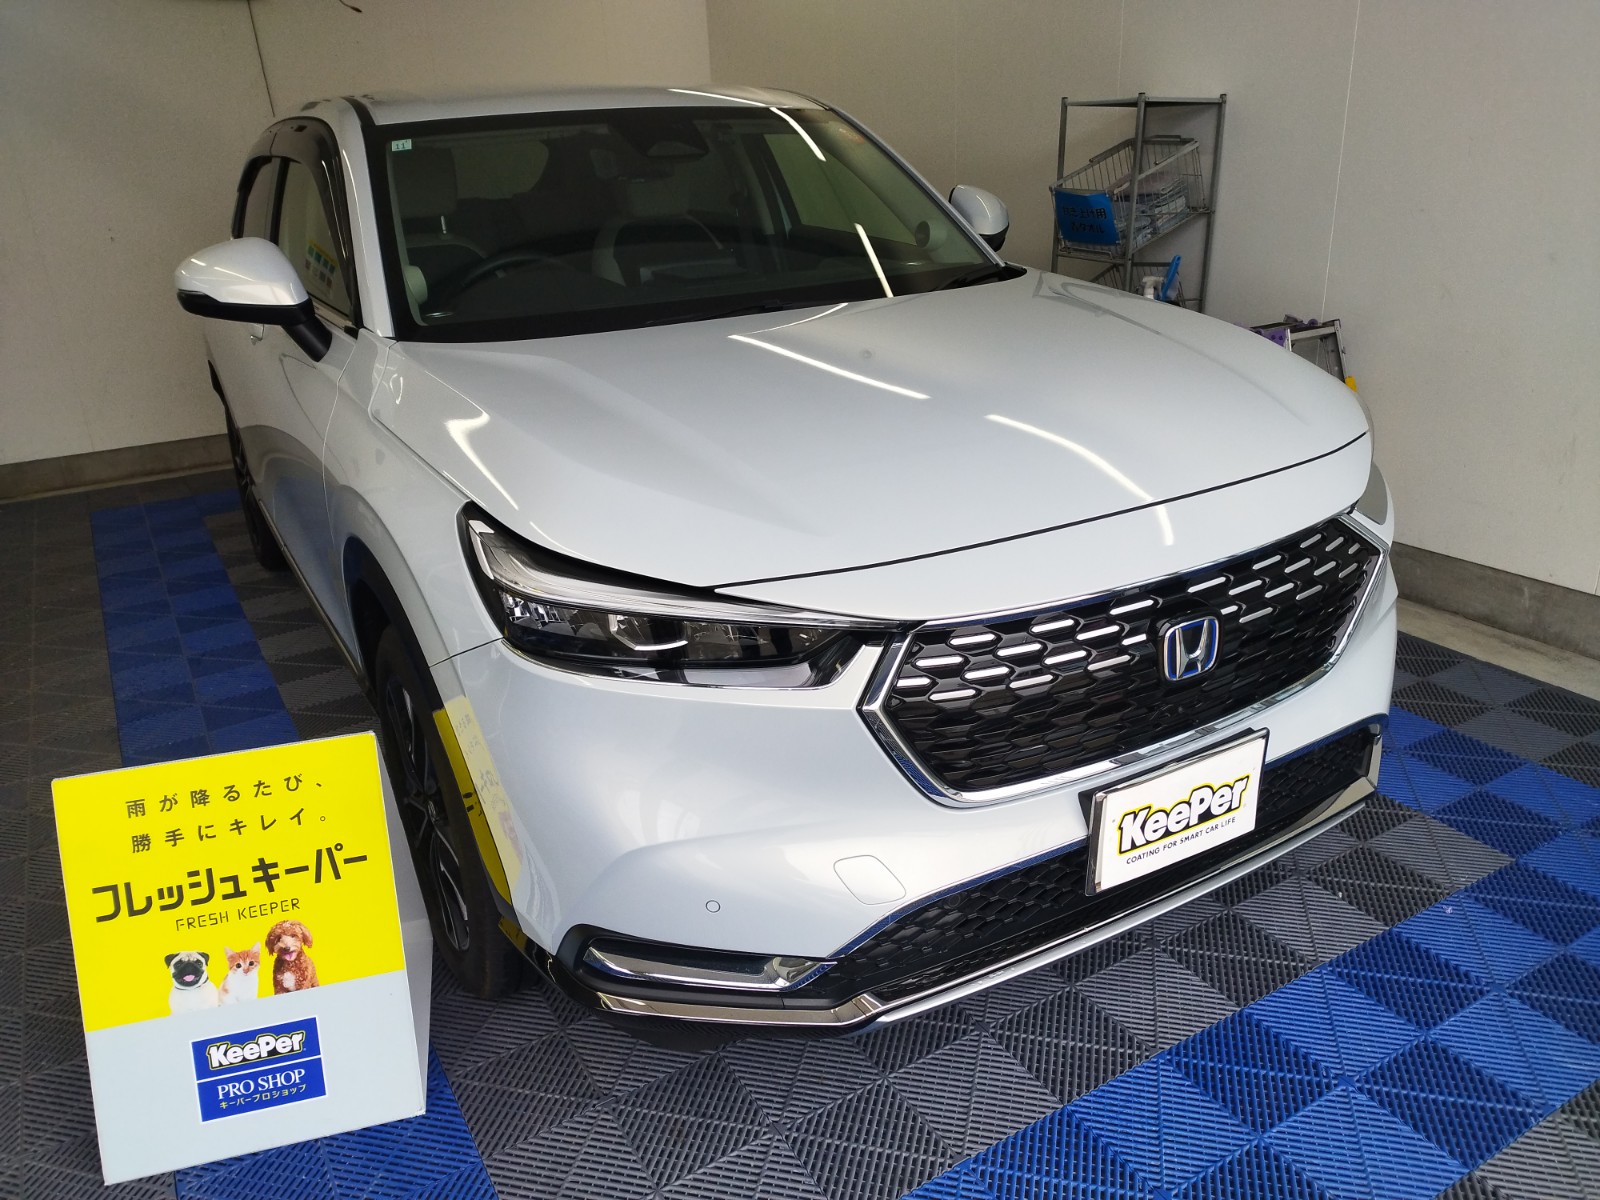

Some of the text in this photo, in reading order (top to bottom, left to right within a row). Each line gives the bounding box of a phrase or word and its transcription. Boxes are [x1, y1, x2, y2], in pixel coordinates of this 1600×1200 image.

[125, 773, 323, 819] 雨が降るたび、
[1119, 775, 1249, 853] KeePer
[131, 807, 326, 854] 勝手にキレイ。
[1126, 816, 1236, 865] COATING FOR SMART CAR LIFE
[91, 842, 368, 923] フレッシュキーパー
[175, 897, 301, 931] FRESH KEEPER
[207, 1031, 305, 1070] KeePer
[217, 1068, 306, 1100] PRO SHOP
[219, 1084, 307, 1110] キーパープロショップ
